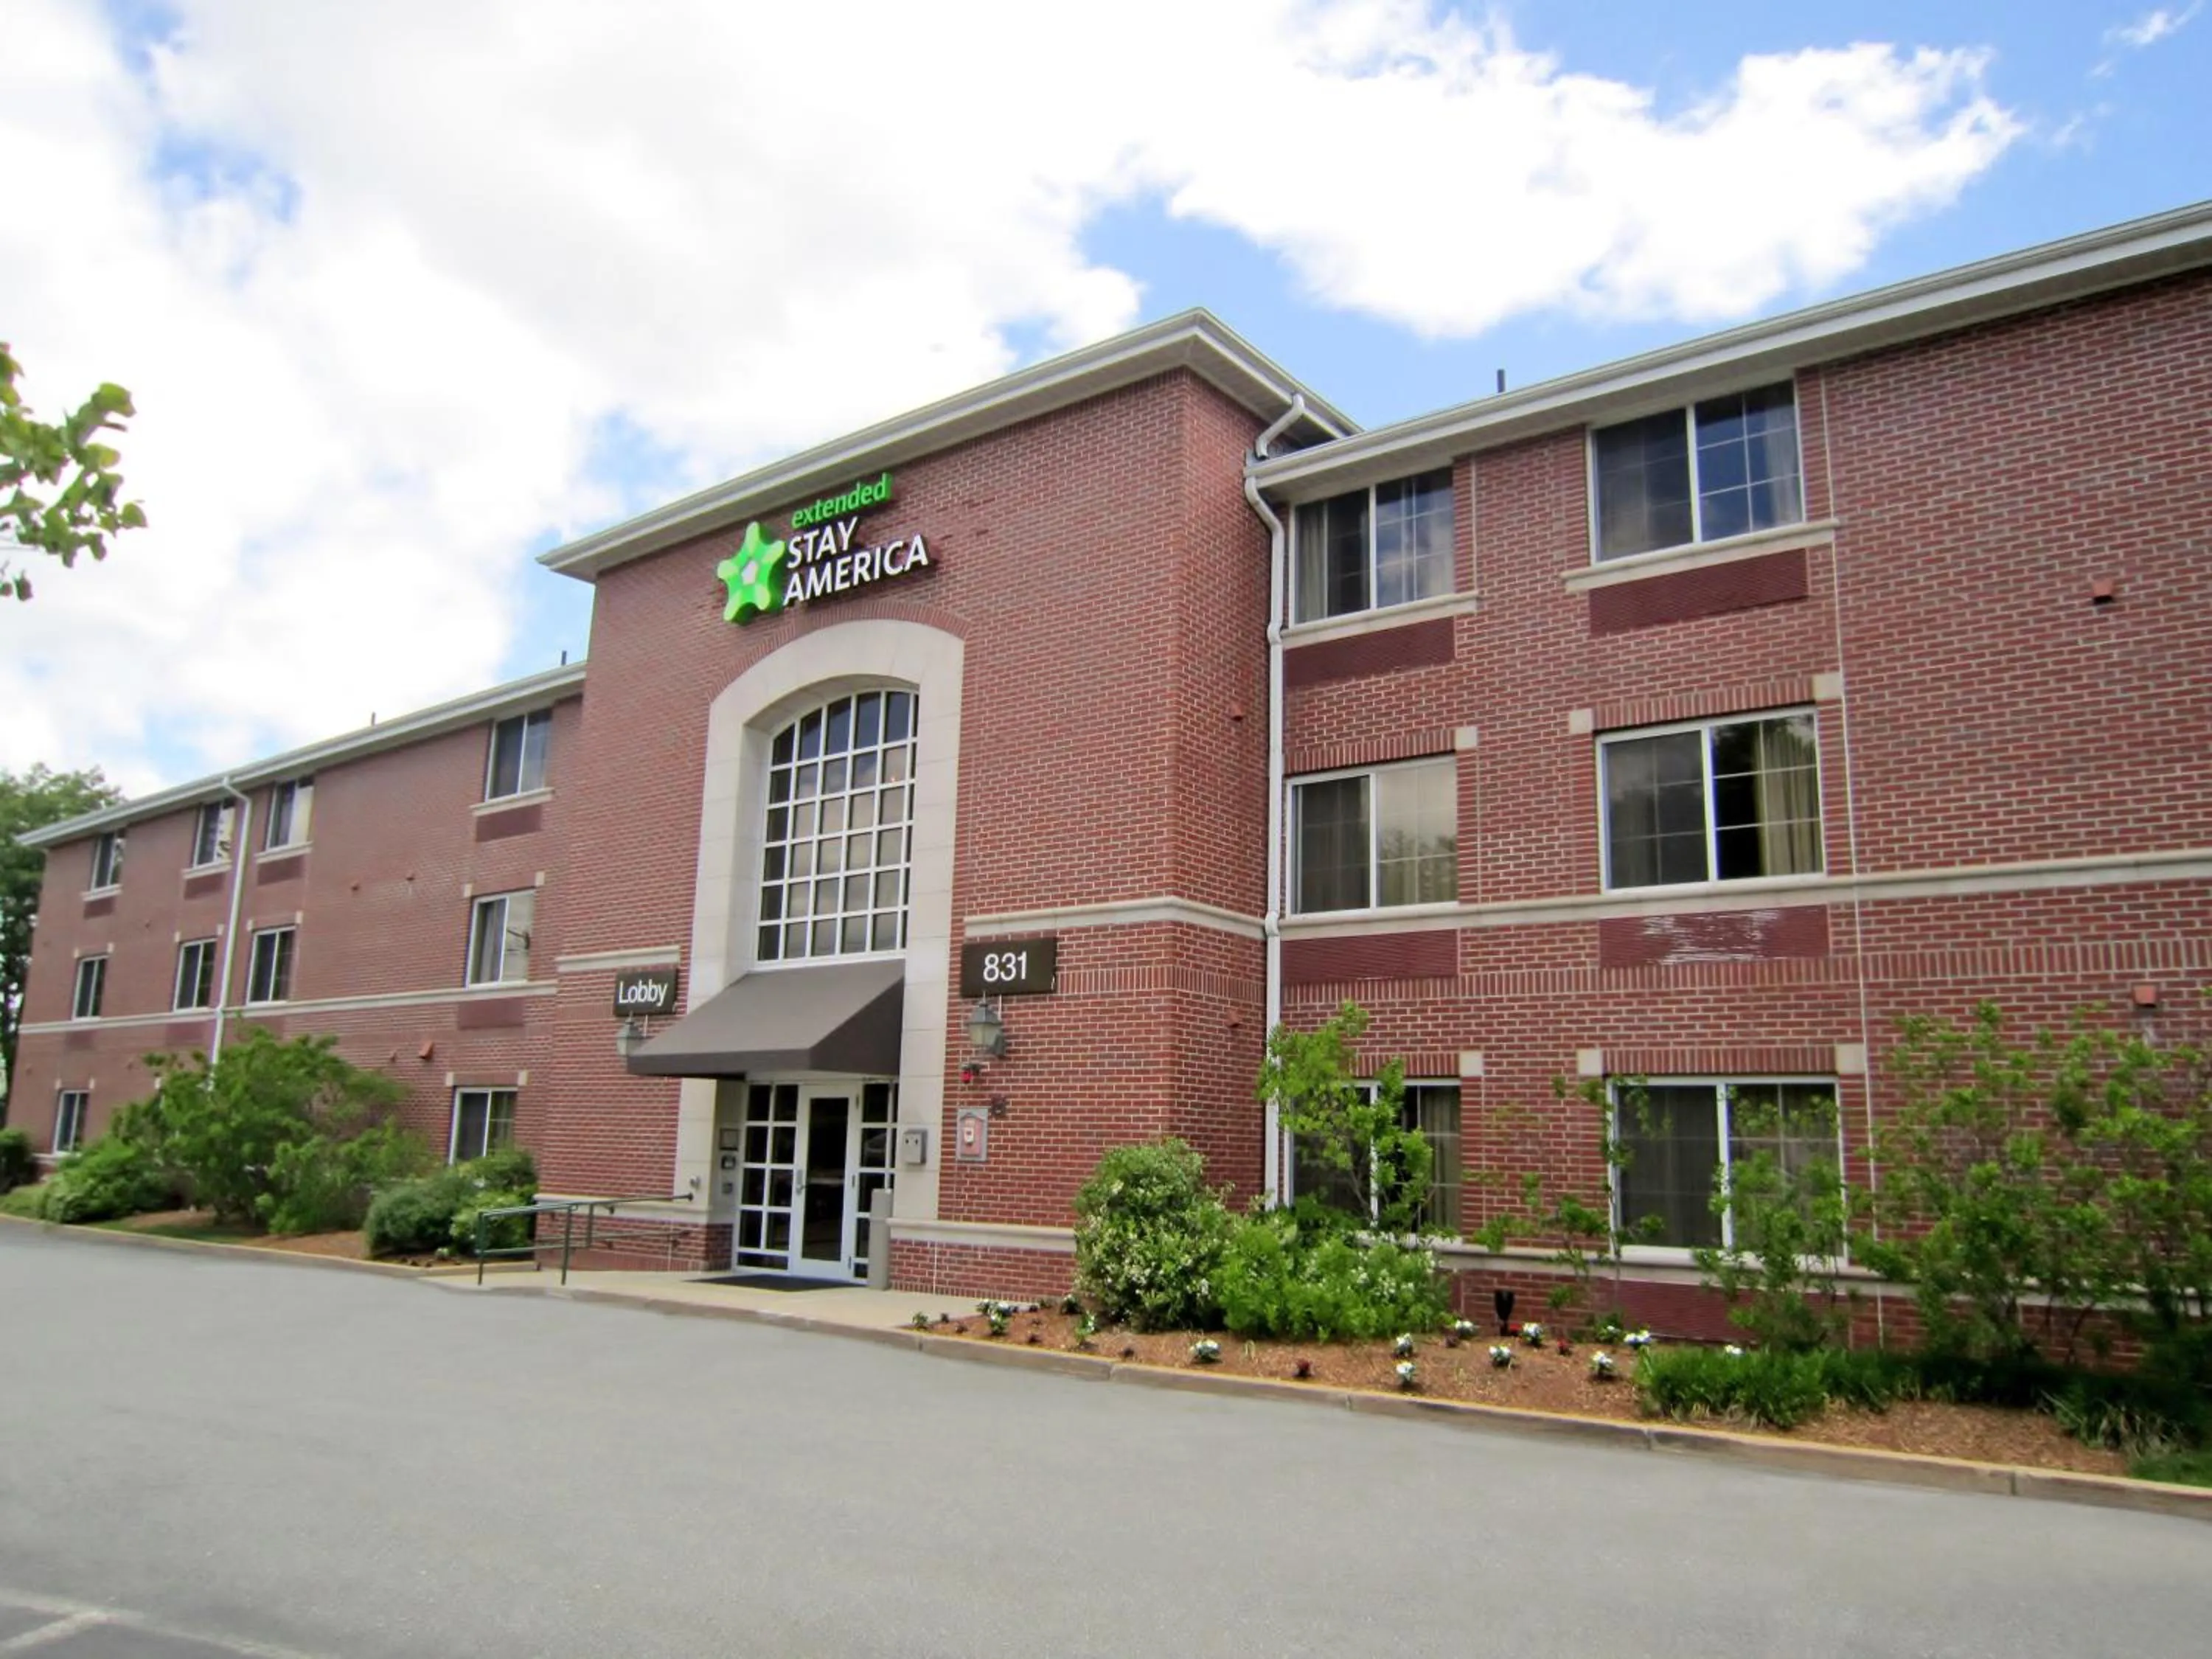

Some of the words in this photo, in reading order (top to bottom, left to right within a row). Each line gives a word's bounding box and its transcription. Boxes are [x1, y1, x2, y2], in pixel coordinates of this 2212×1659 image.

[791, 472, 892, 528] extended
[786, 516, 858, 569] STAY
[783, 534, 929, 606] AMERICA
[619, 978, 669, 1007] Lobby
[983, 950, 1027, 982] 831
